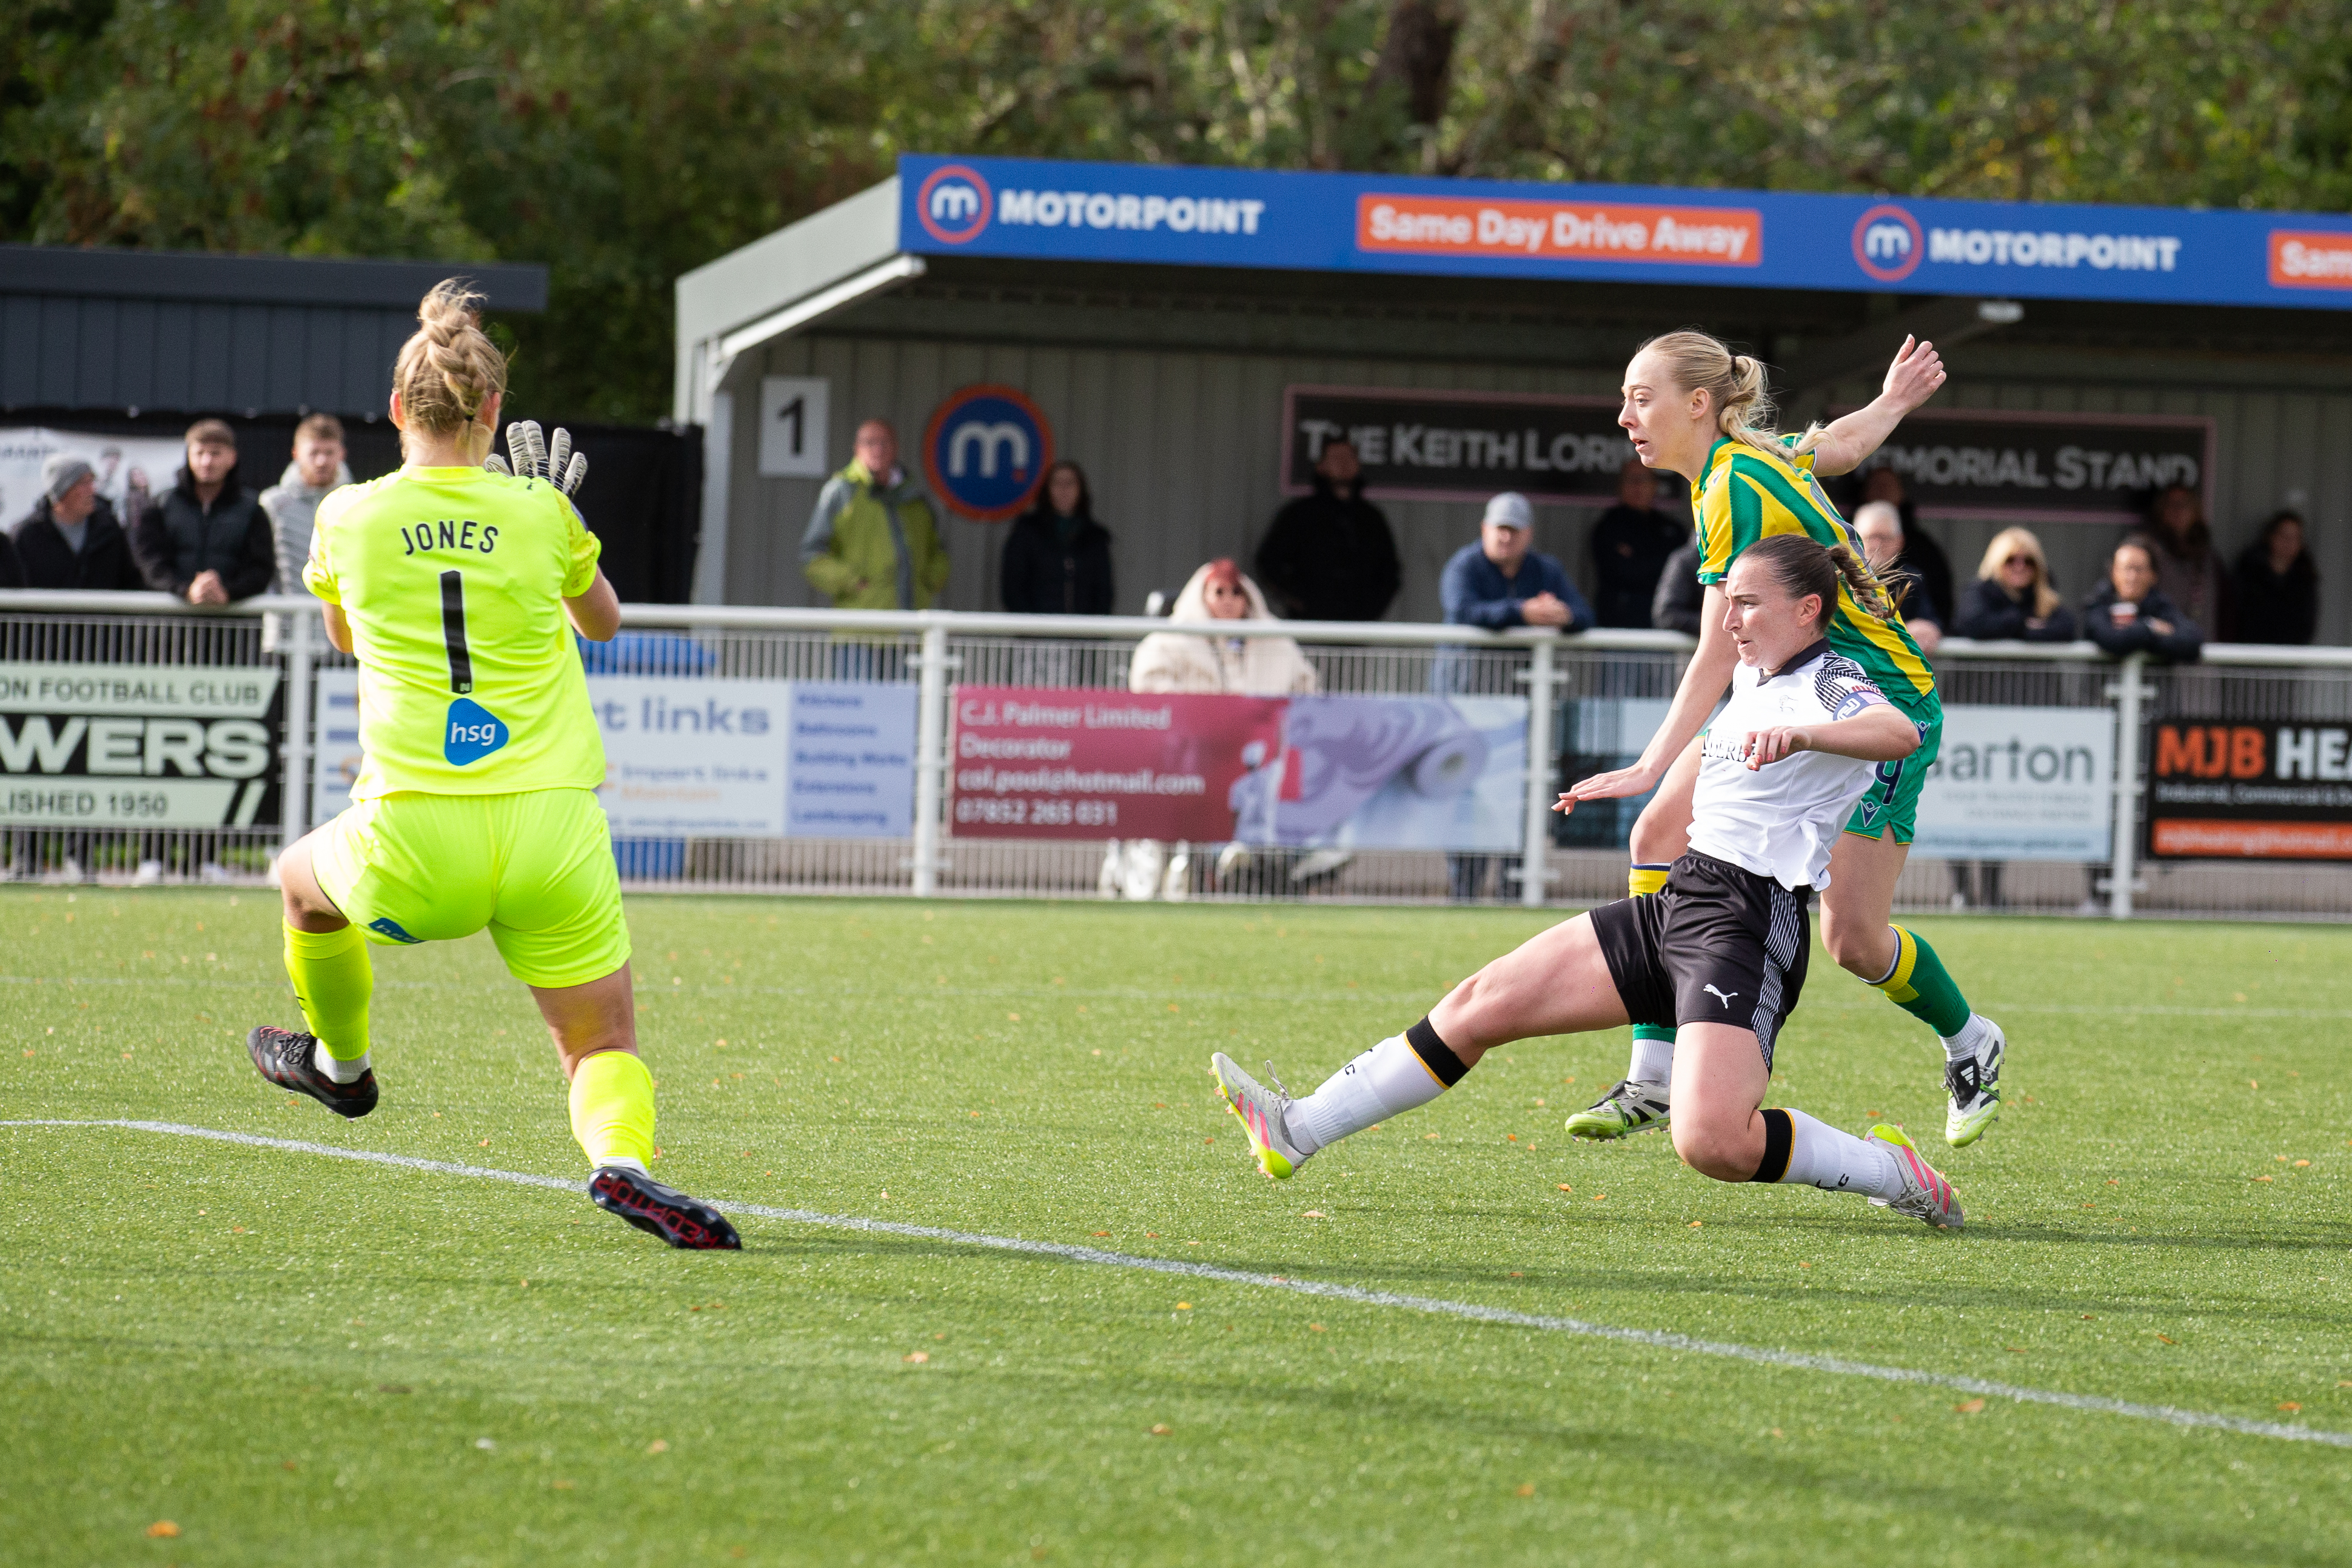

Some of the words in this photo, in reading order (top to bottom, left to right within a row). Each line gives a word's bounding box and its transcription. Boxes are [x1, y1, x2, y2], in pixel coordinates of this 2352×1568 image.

[999, 189, 1265, 234] MOTORPOINT
[1369, 203, 1473, 243] Same
[1477, 208, 1549, 252] Day
[1552, 211, 1647, 252] Drive
[1653, 215, 1749, 261] Away
[1929, 228, 2182, 271] MOTORPOINT
[776, 395, 805, 458] 1
[1392, 422, 1520, 470] KEITH
[400, 520, 499, 556] JONES
[439, 569, 473, 695] 1
[38, 676, 180, 706] FOOTBALL
[189, 678, 261, 706] CLUB
[451, 721, 496, 746] hsg
[640, 696, 771, 735] links
[1003, 702, 1081, 727] Palmer
[1085, 704, 1171, 729] Limited
[960, 733, 1073, 759] Decorator
[2156, 725, 2267, 779] MJB
[2275, 726, 2352, 782] HE
[0, 788, 96, 817] ISHED
[108, 791, 169, 819] 1950
